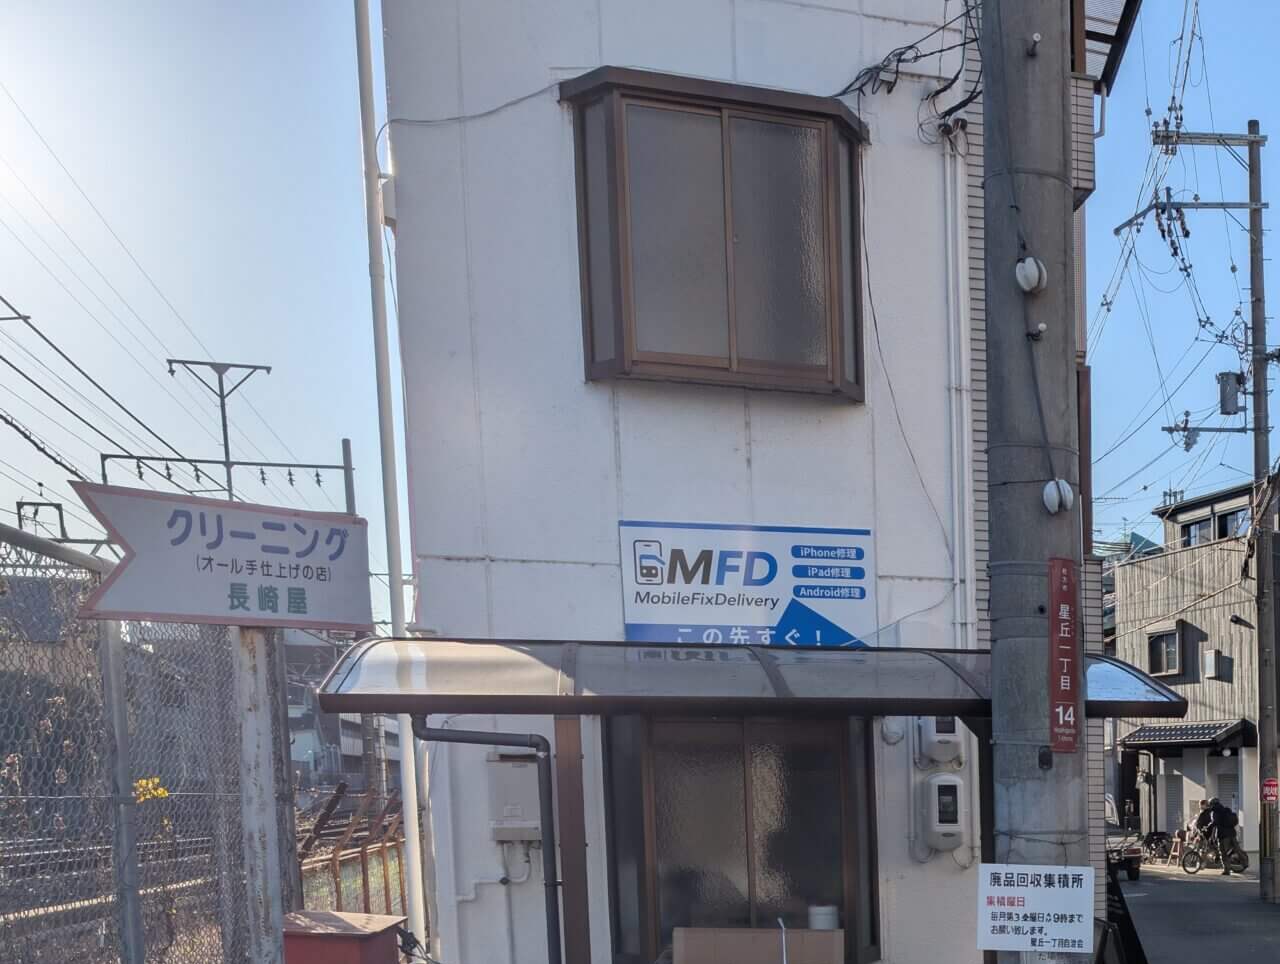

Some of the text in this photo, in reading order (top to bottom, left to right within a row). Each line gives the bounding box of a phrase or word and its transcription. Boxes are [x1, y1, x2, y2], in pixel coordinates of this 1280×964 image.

[166, 509, 349, 561] クリーニング
[196, 555, 331, 582] (オール手仕上げの店)
[667, 548, 778, 586] MFD
[634, 591, 780, 610] MobileFixDelivery
[1058, 603, 1072, 690] 星丘一丁目
[1055, 705, 1075, 725] 14
[989, 872, 1084, 888] 廃品回収集積所
